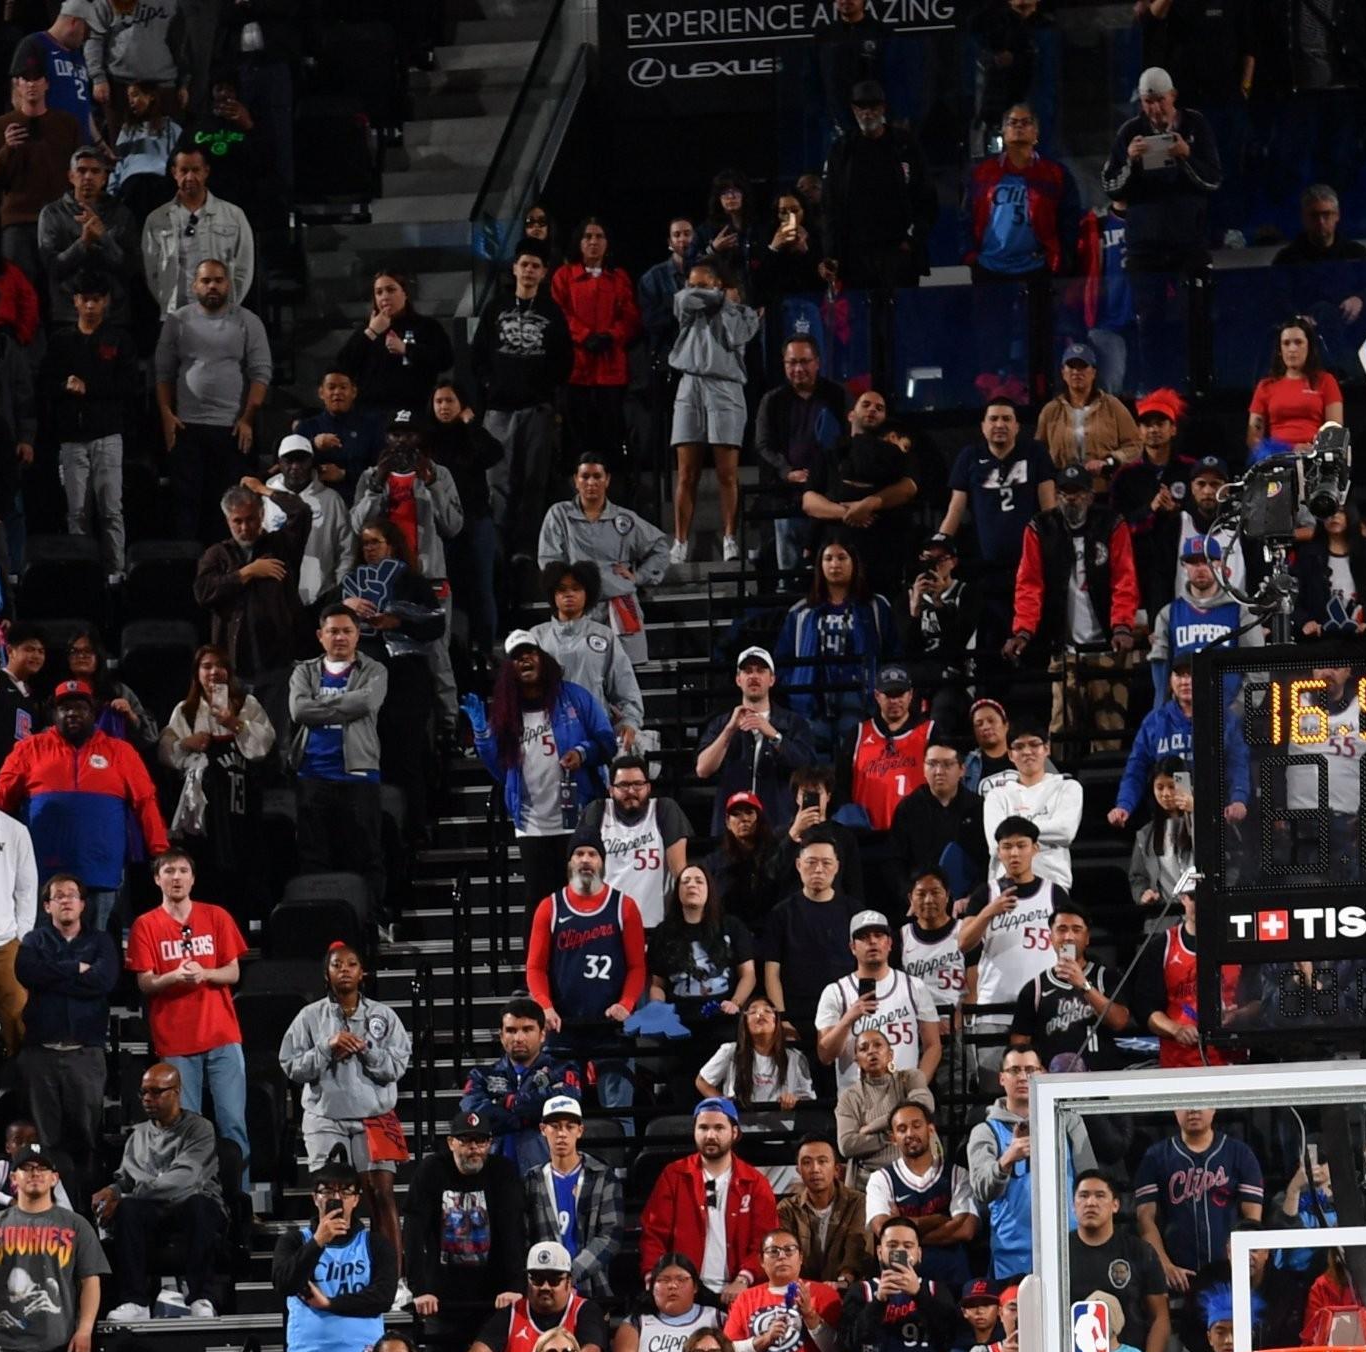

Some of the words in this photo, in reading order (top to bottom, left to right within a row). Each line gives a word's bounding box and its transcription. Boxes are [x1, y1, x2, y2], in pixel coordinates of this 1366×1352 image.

[627, 2, 805, 40] EXPERIENCE
[812, 0, 955, 31] AZING
[670, 58, 775, 79] LEXUS
[999, 486, 1015, 513] 2
[895, 774, 906, 796] 1
[603, 831, 656, 858] Clippers
[633, 848, 661, 872] 55
[990, 905, 1051, 933] Clippers
[556, 922, 615, 952] Clippers
[1022, 927, 1051, 952] 55
[582, 954, 612, 981] 32
[938, 967, 966, 992] 55
[851, 1006, 910, 1039] Clippers
[886, 1022, 915, 1048] 55
[1166, 1166, 1229, 1205] Clips
